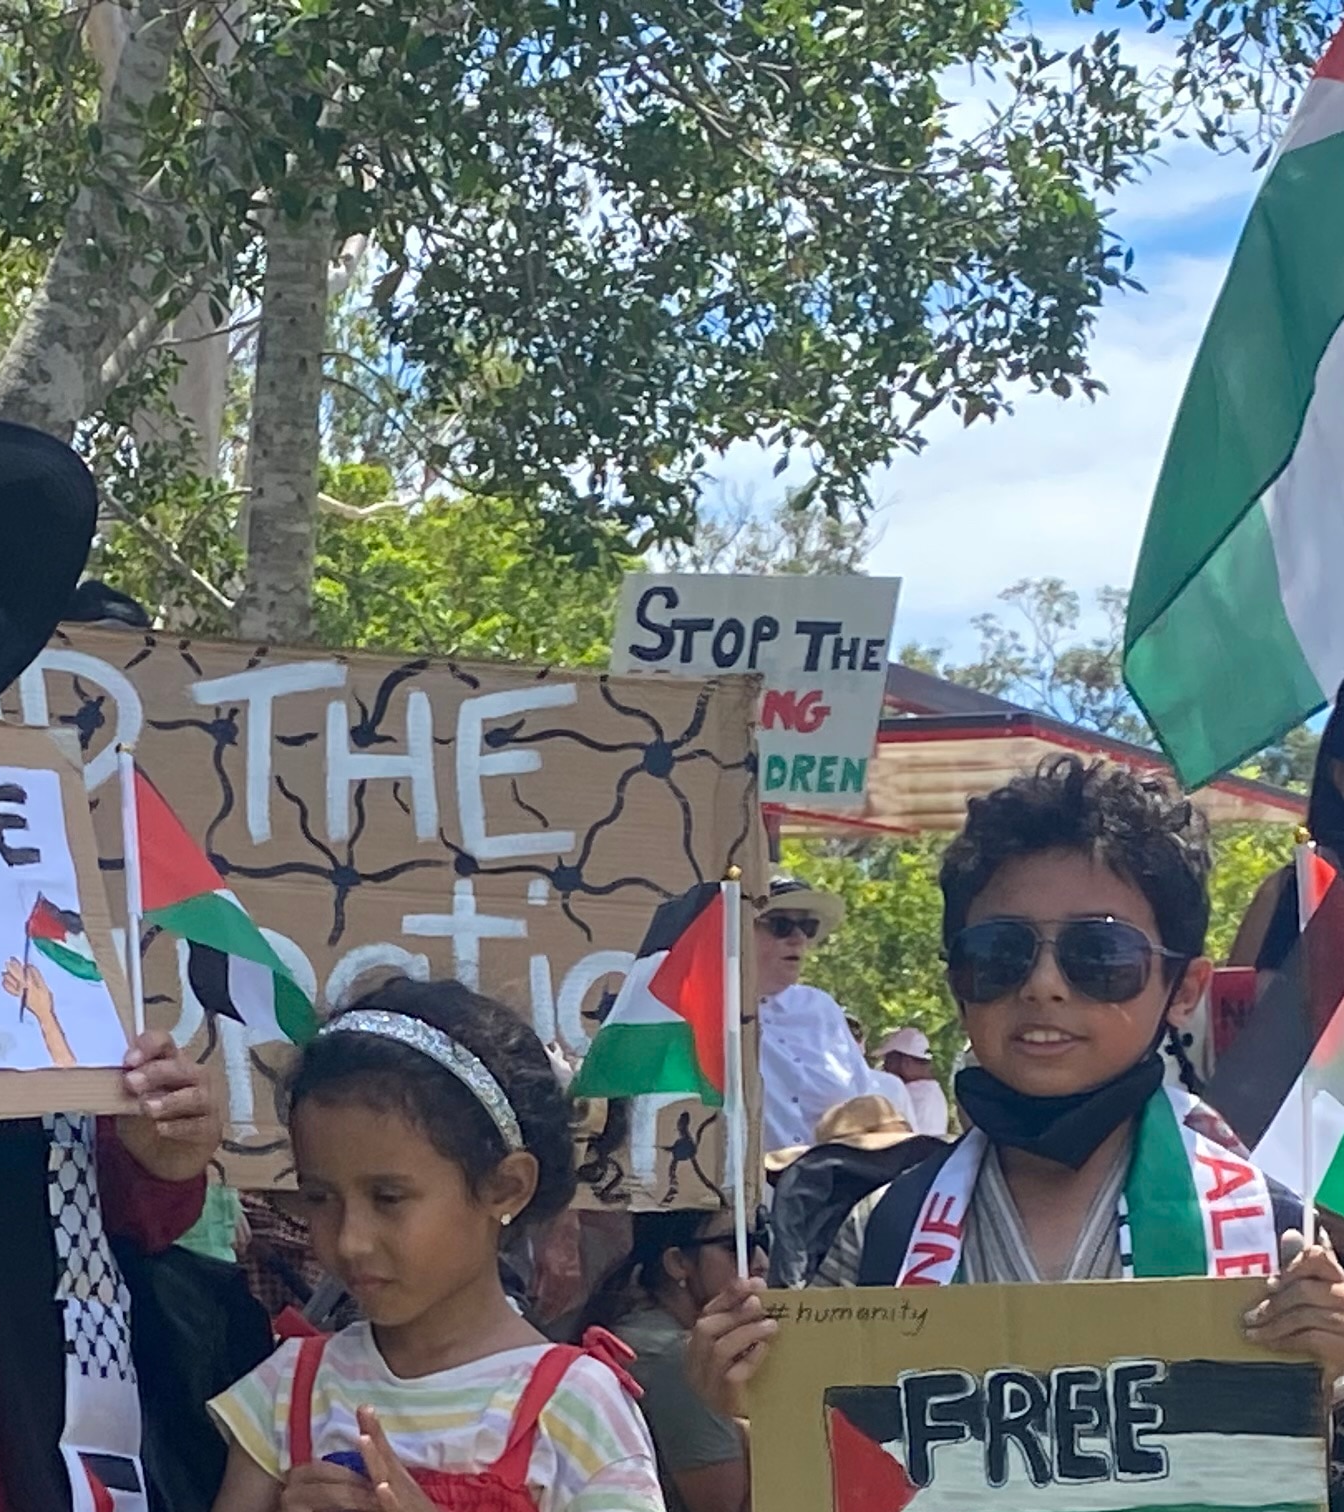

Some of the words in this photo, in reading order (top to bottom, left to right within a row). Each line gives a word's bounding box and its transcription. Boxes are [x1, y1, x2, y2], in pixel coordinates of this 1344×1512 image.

[628, 585, 780, 670] STOP
[794, 620, 886, 672] THE
[757, 688, 831, 734] NG
[191, 658, 578, 862] THE
[764, 753, 868, 794] DREN
[763, 1298, 930, 1337] #humanity
[897, 1358, 1170, 1489] FREE
